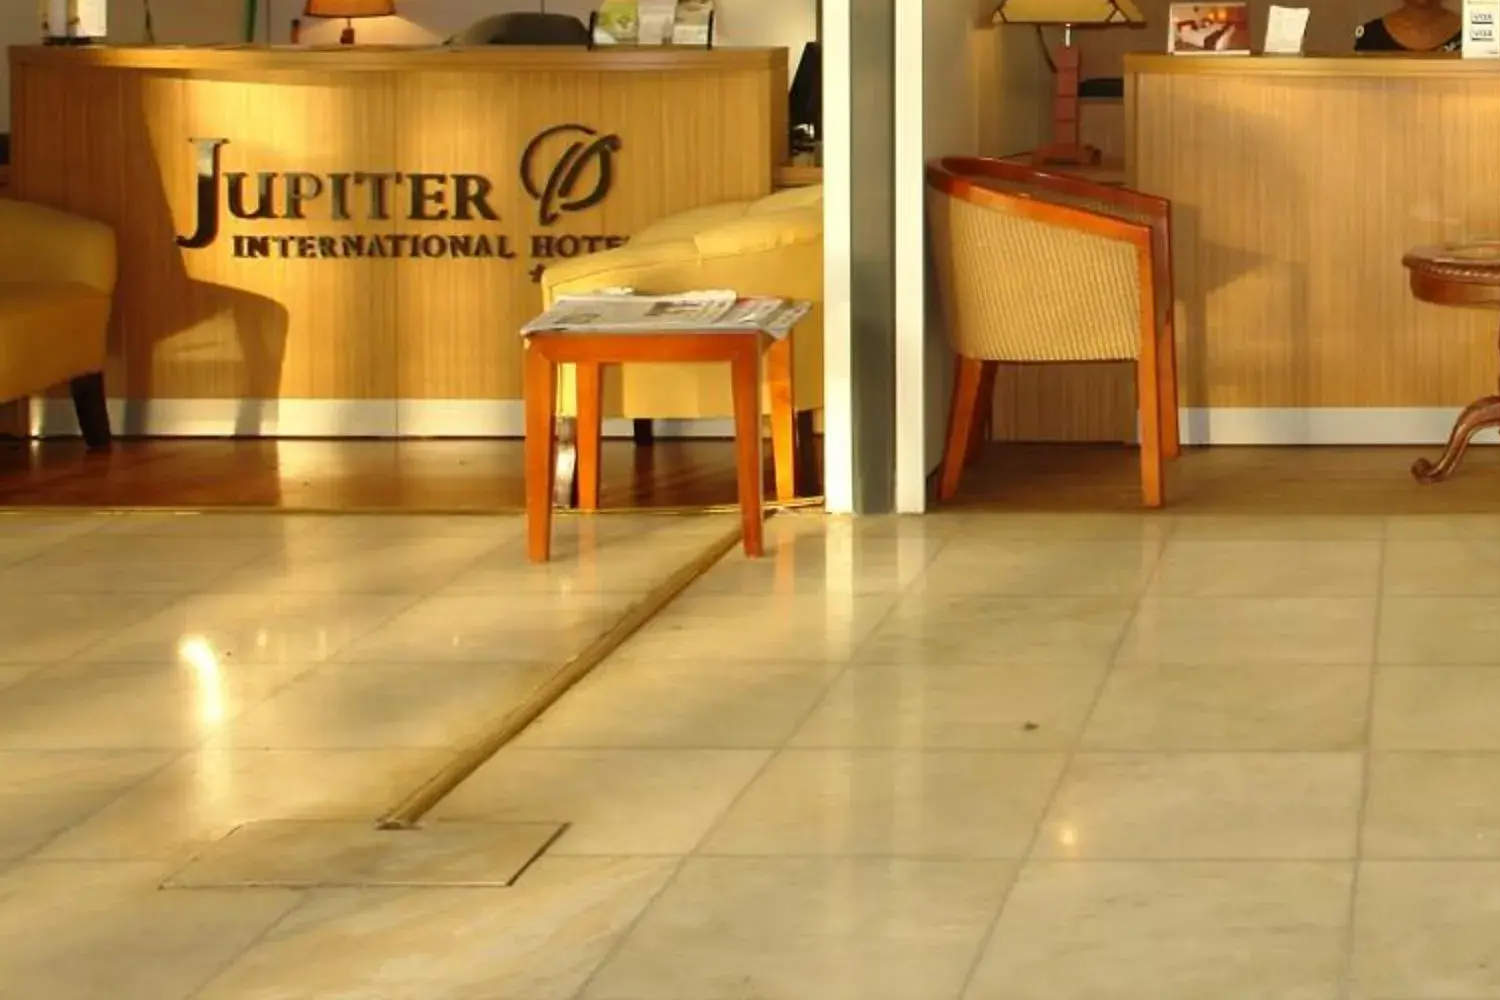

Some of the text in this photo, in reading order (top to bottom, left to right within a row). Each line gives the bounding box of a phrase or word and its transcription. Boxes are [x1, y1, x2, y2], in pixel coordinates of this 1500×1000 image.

[175, 137, 501, 249] JUPITER
[232, 234, 631, 259] INTERNATIONAL HOTE
